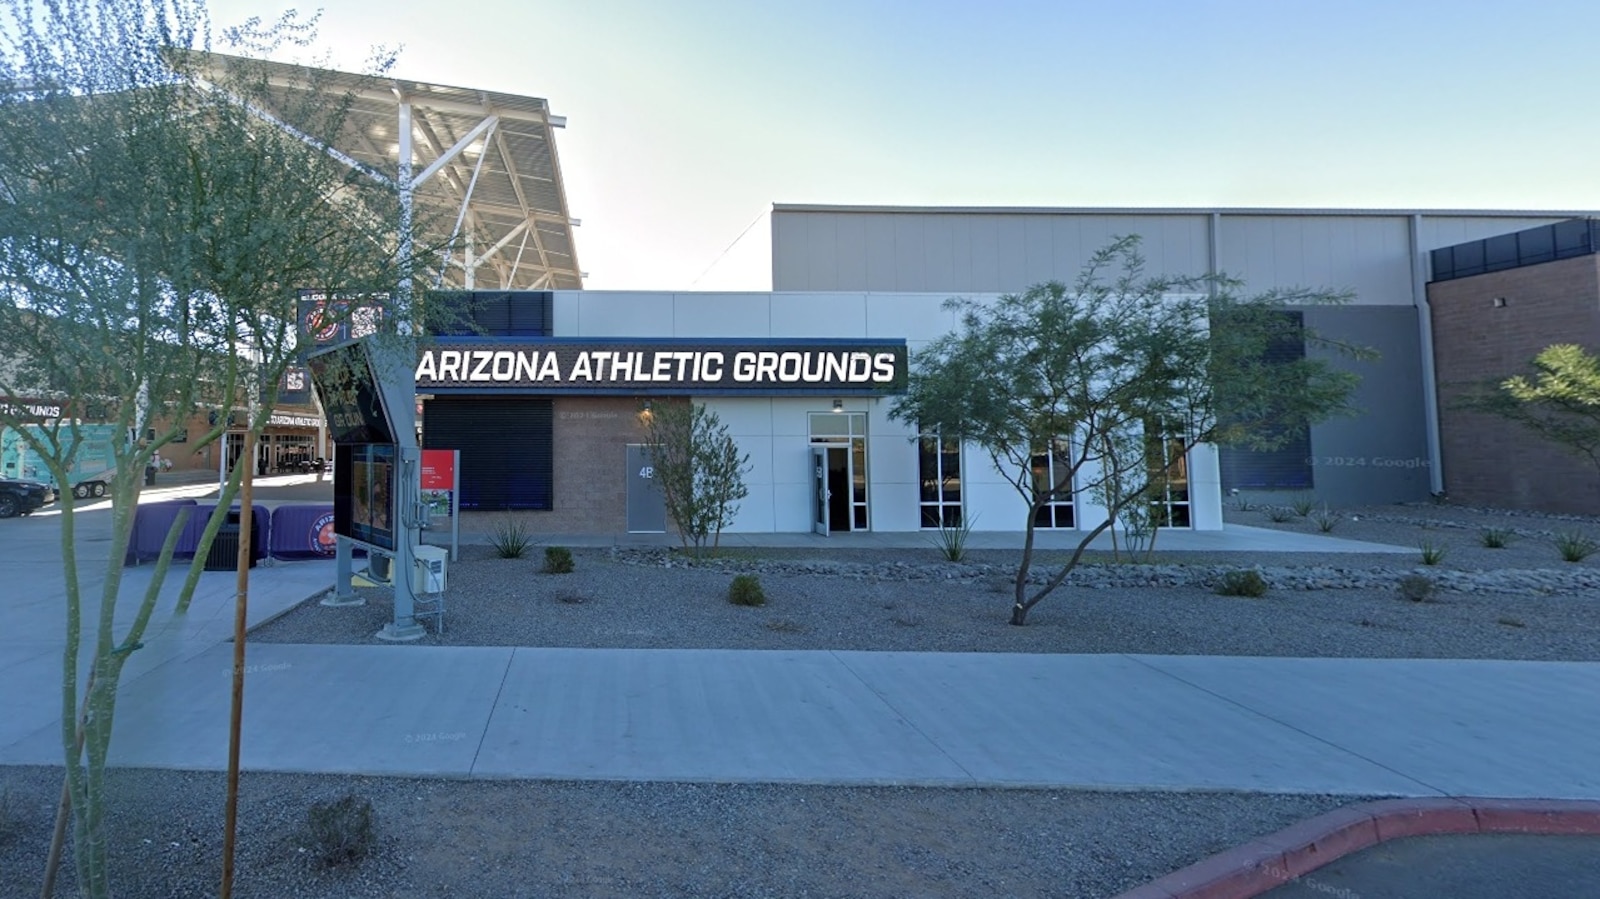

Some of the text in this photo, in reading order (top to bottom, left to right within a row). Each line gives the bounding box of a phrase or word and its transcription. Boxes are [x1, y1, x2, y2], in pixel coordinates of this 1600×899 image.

[415, 350, 896, 383] ARIZONA ATHLETIC GROUNDS
[639, 466, 654, 479] 4B
